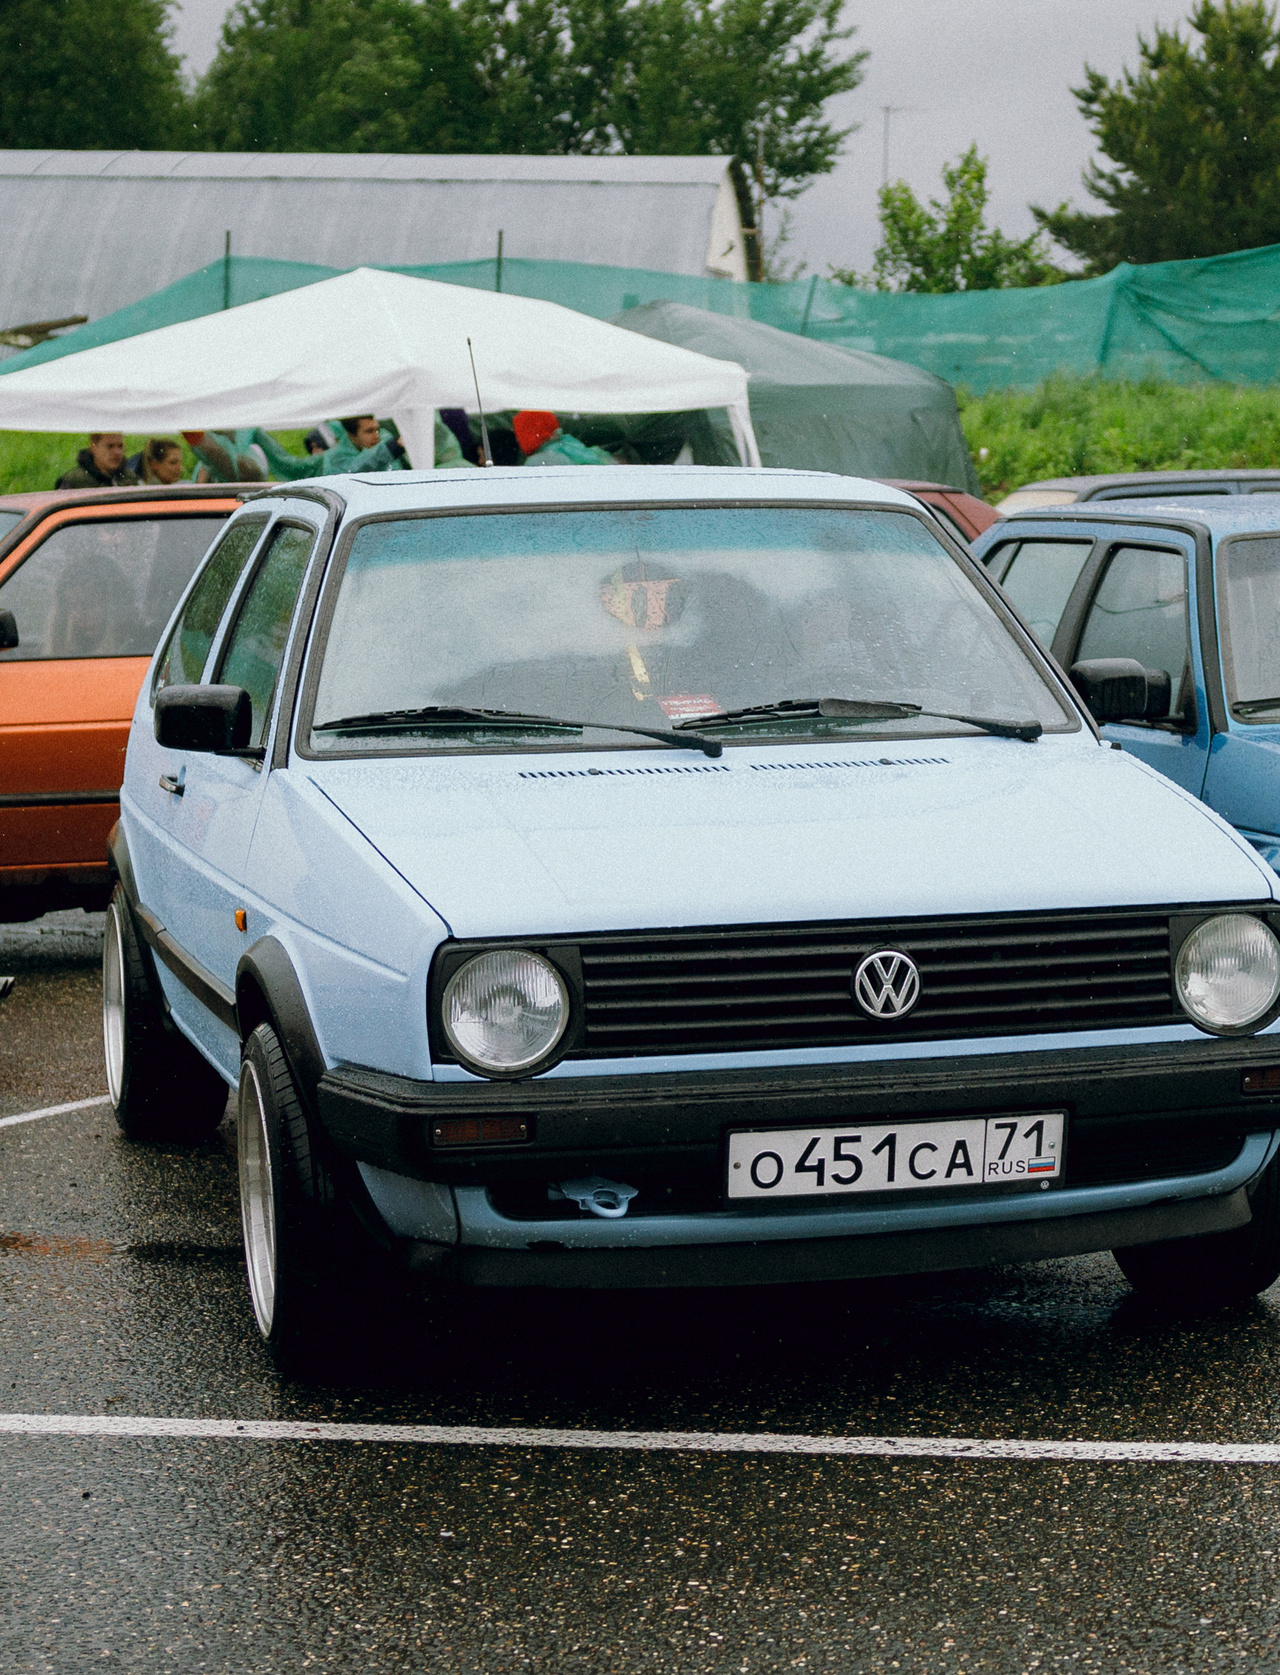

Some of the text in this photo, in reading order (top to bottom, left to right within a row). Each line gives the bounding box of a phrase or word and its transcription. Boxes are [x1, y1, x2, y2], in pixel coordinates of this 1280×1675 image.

[855, 951, 919, 1018] VW
[750, 1119, 1045, 1189] O451CA 71
[987, 1159, 1026, 1176] RUS
